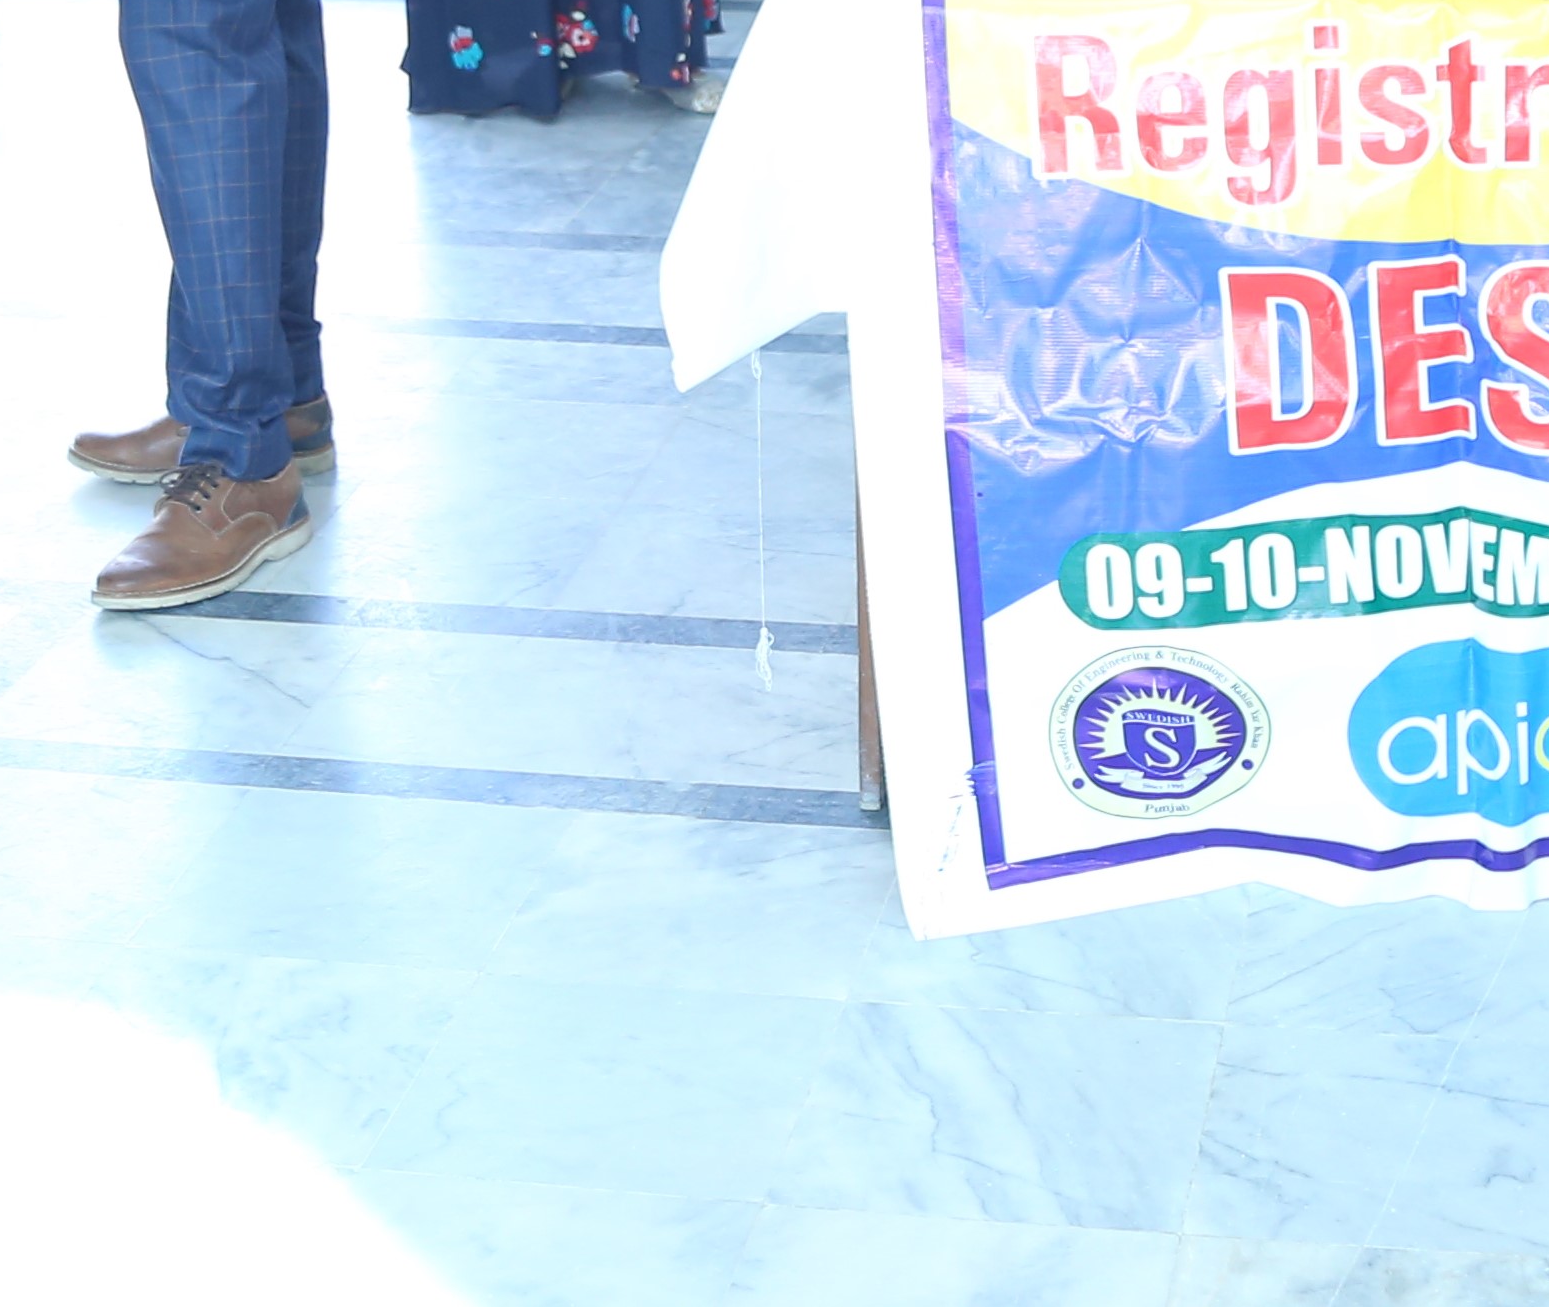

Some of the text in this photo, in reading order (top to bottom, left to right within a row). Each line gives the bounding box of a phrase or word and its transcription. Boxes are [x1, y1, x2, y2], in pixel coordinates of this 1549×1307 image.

[1056, 728, 1075, 771] Swedish
[1084, 651, 1150, 682] Engineering
[1155, 650, 1165, 660] &
[1169, 651, 1229, 684] Technology
[1125, 711, 1192, 724] SWEDISH
[1143, 726, 1182, 769] S
[1144, 803, 1190, 814] Punjab
